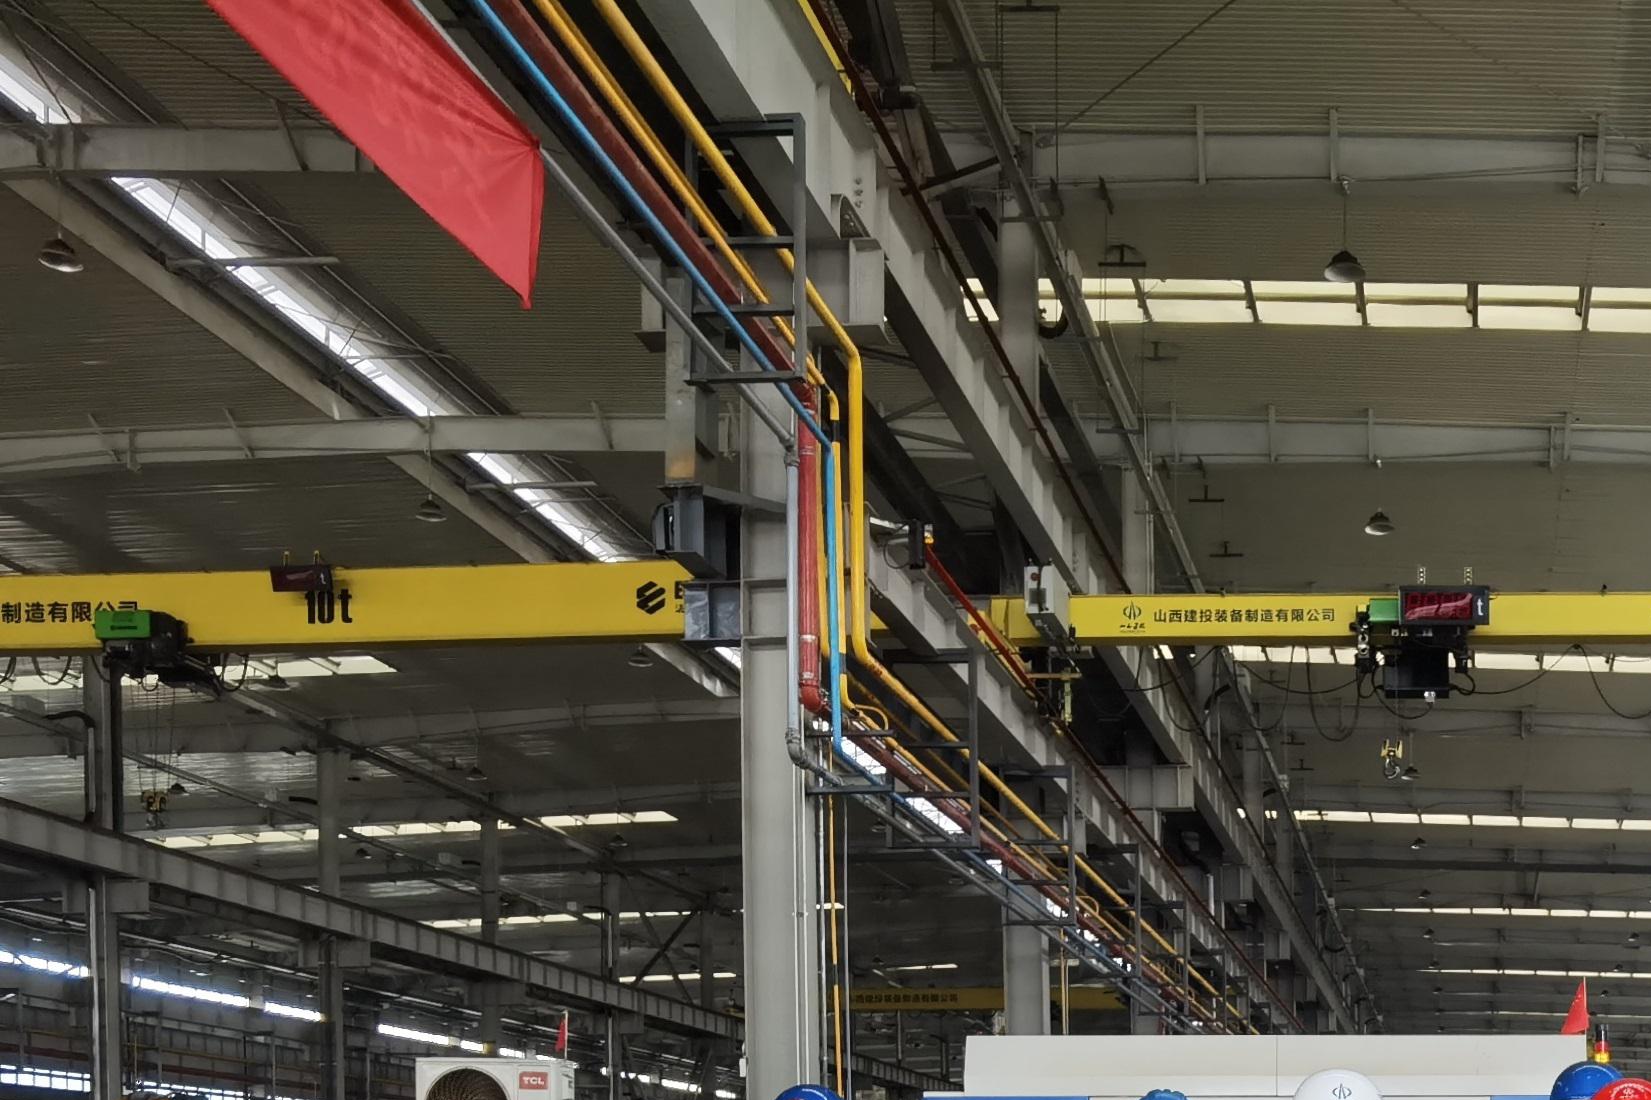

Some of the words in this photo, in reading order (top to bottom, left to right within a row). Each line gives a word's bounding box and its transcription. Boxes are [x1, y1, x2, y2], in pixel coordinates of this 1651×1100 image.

[305, 588, 352, 624] 10t
[1153, 608, 1336, 624] 山西建投装备制造有限公司
[522, 1076, 545, 1086] TCL
